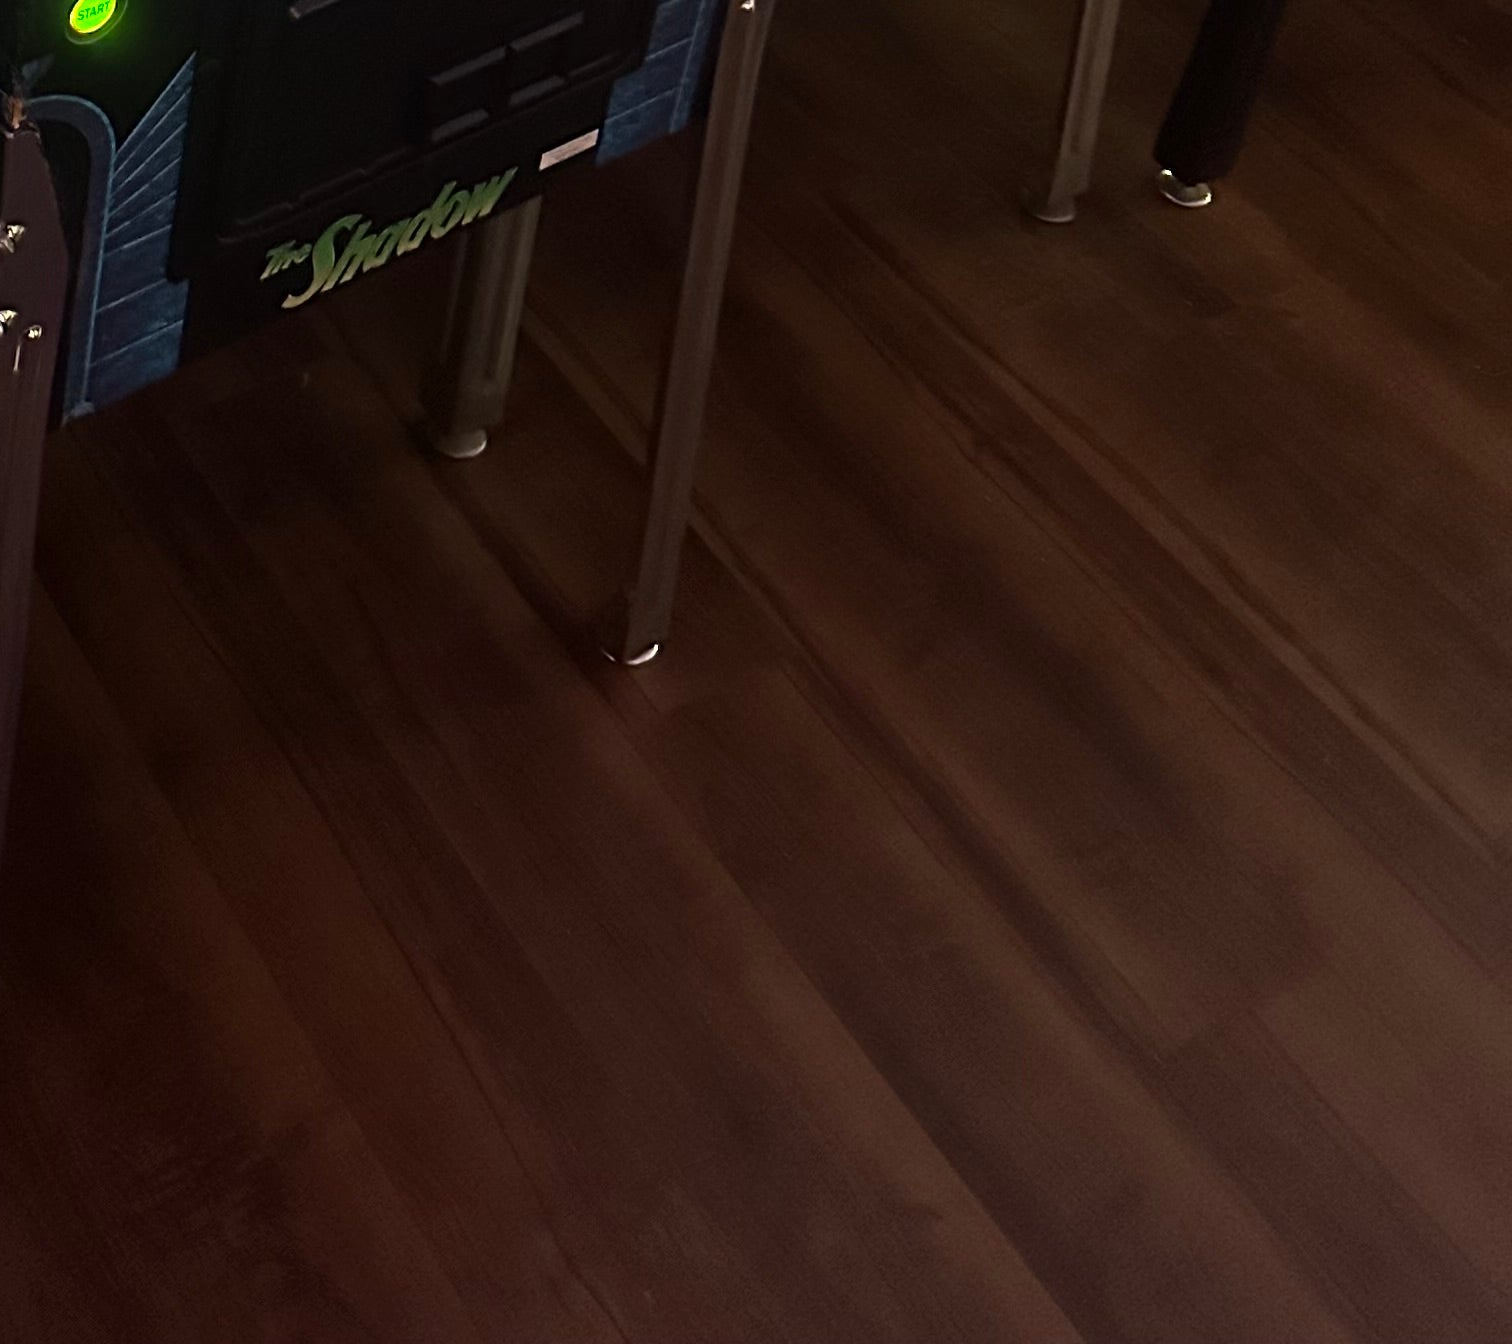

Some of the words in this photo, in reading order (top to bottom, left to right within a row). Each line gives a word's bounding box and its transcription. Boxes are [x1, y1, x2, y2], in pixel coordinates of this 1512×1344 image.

[76, 0, 112, 23] START
[281, 166, 520, 309] Shadow
[259, 240, 313, 281] The
